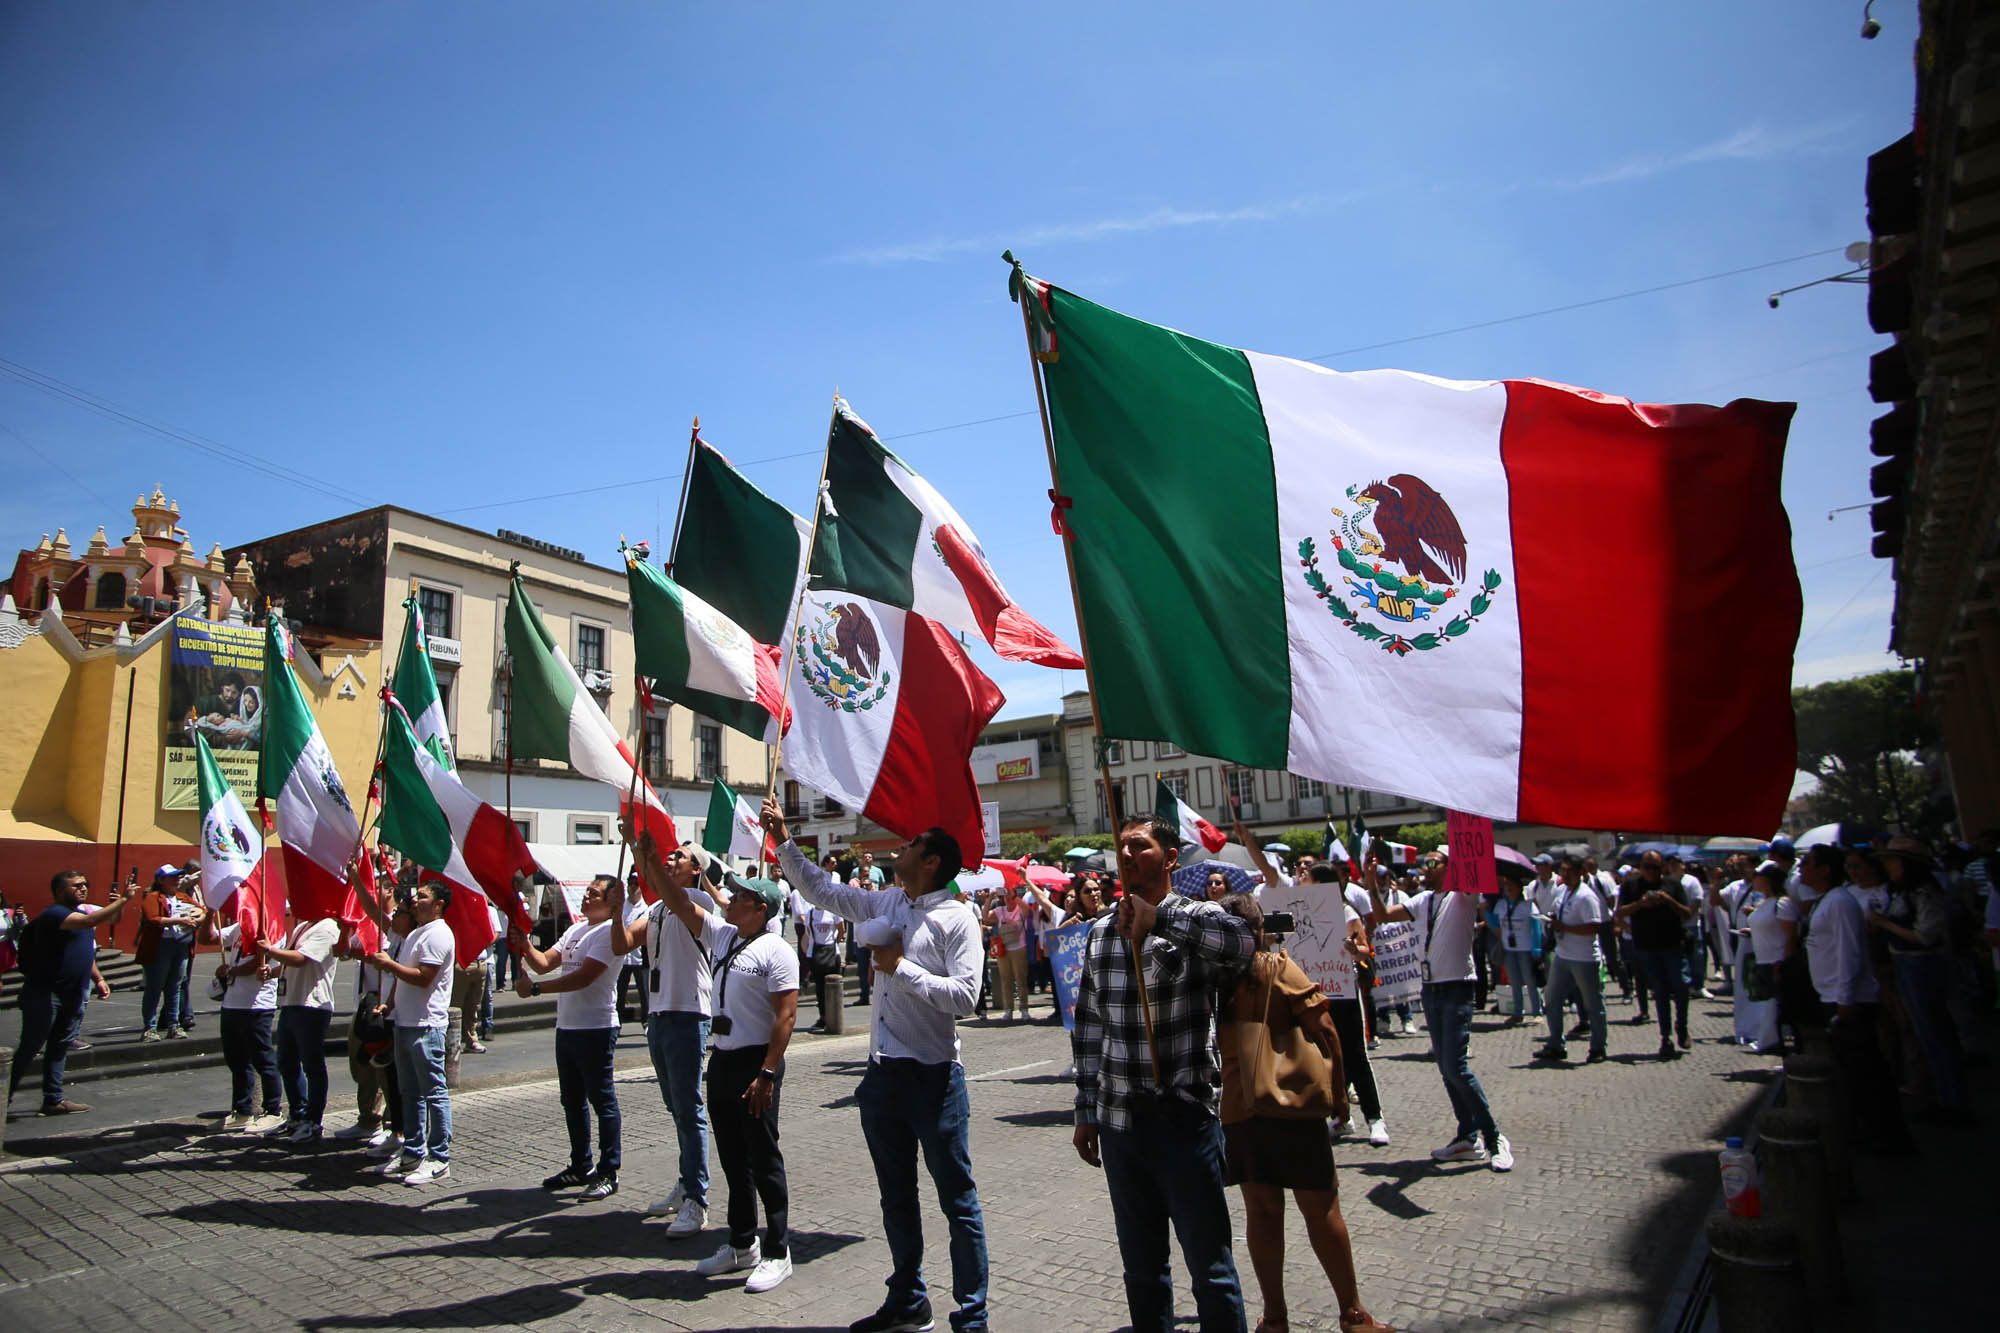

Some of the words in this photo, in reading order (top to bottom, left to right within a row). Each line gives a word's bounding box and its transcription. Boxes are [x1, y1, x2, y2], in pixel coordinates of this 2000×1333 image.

[176, 616, 209, 633] CATEDRAL
[178, 638, 217, 653] ENCUENTRO
[217, 643, 227, 654] DE
[430, 642, 459, 656] RIBUNA
[222, 768, 249, 776] NFORMES
[1375, 952, 1420, 972] ARRERA
[1380, 968, 1422, 987] UDICIAL
